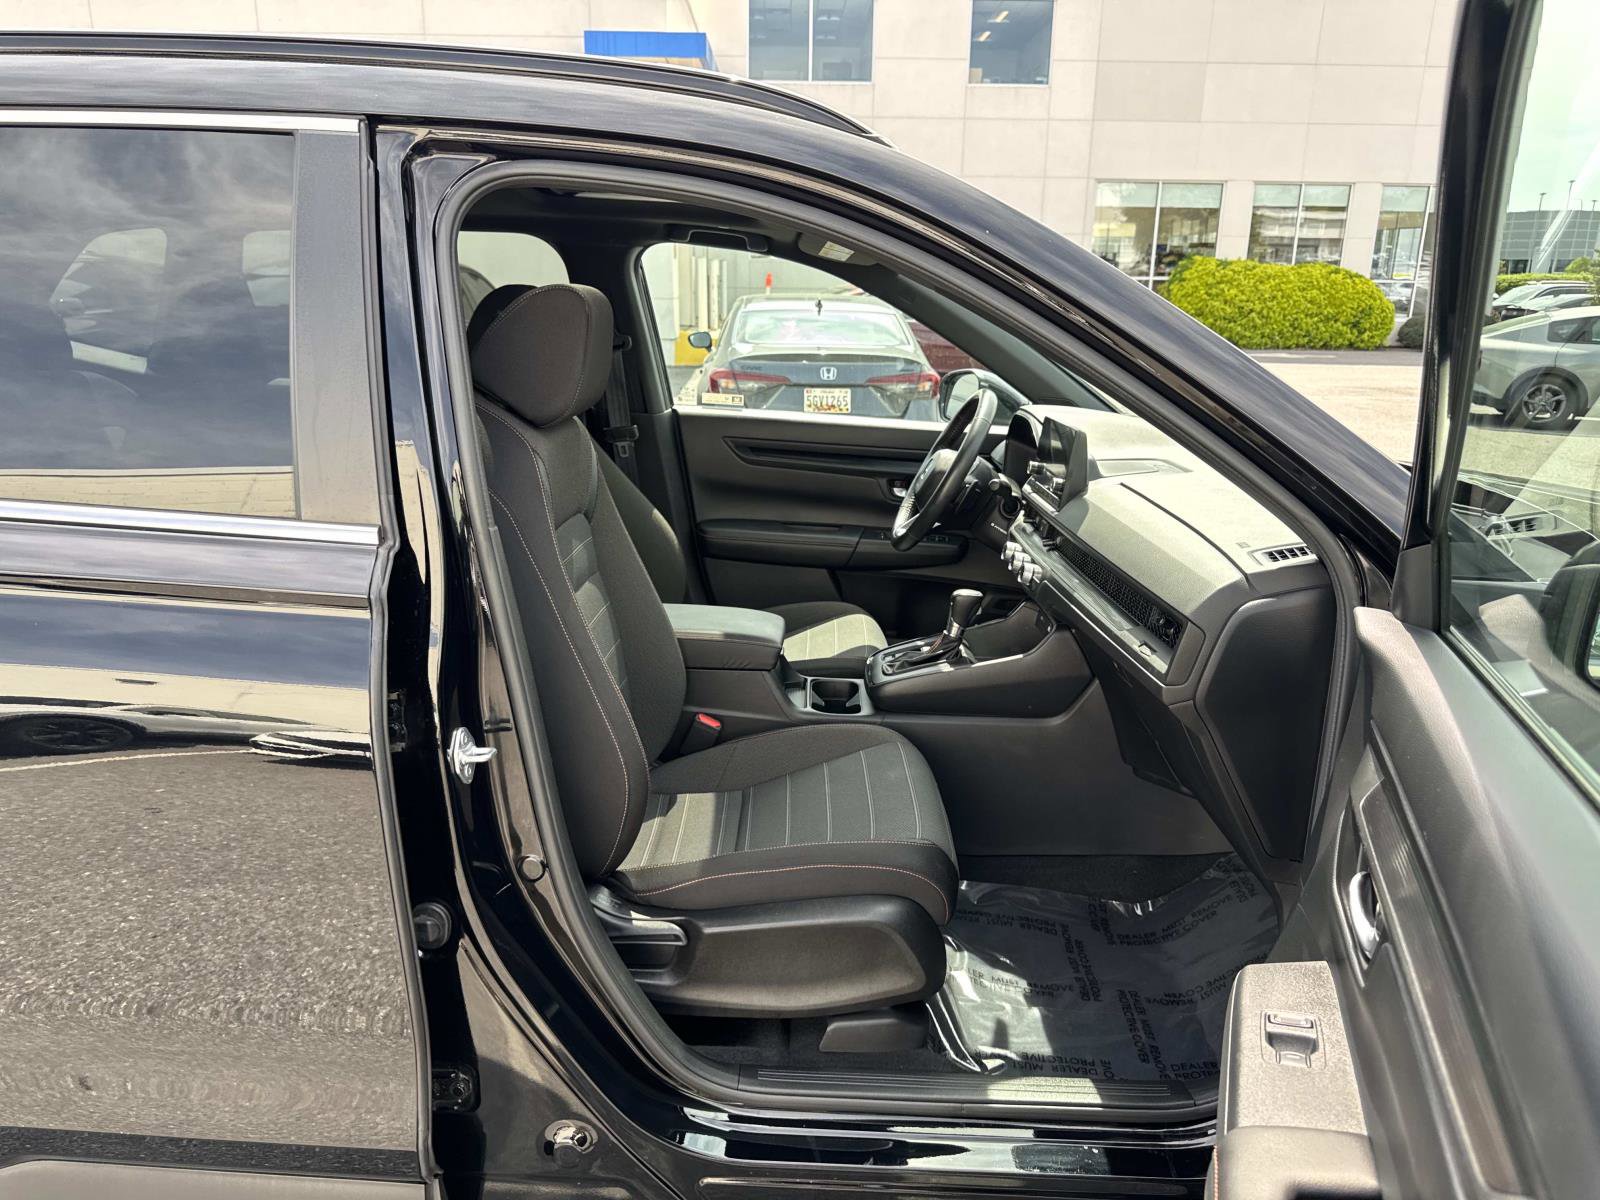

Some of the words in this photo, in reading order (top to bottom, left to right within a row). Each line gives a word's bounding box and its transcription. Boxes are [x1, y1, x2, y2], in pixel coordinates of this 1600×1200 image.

[1190, 894, 1232, 918] REMOVE
[1182, 910, 1217, 932] COVER
[1163, 984, 1204, 999] COVER
[1200, 981, 1227, 1000] MUST
[1051, 1064, 1098, 1076] DEALER
[1170, 1061, 1218, 1072] DEALER
